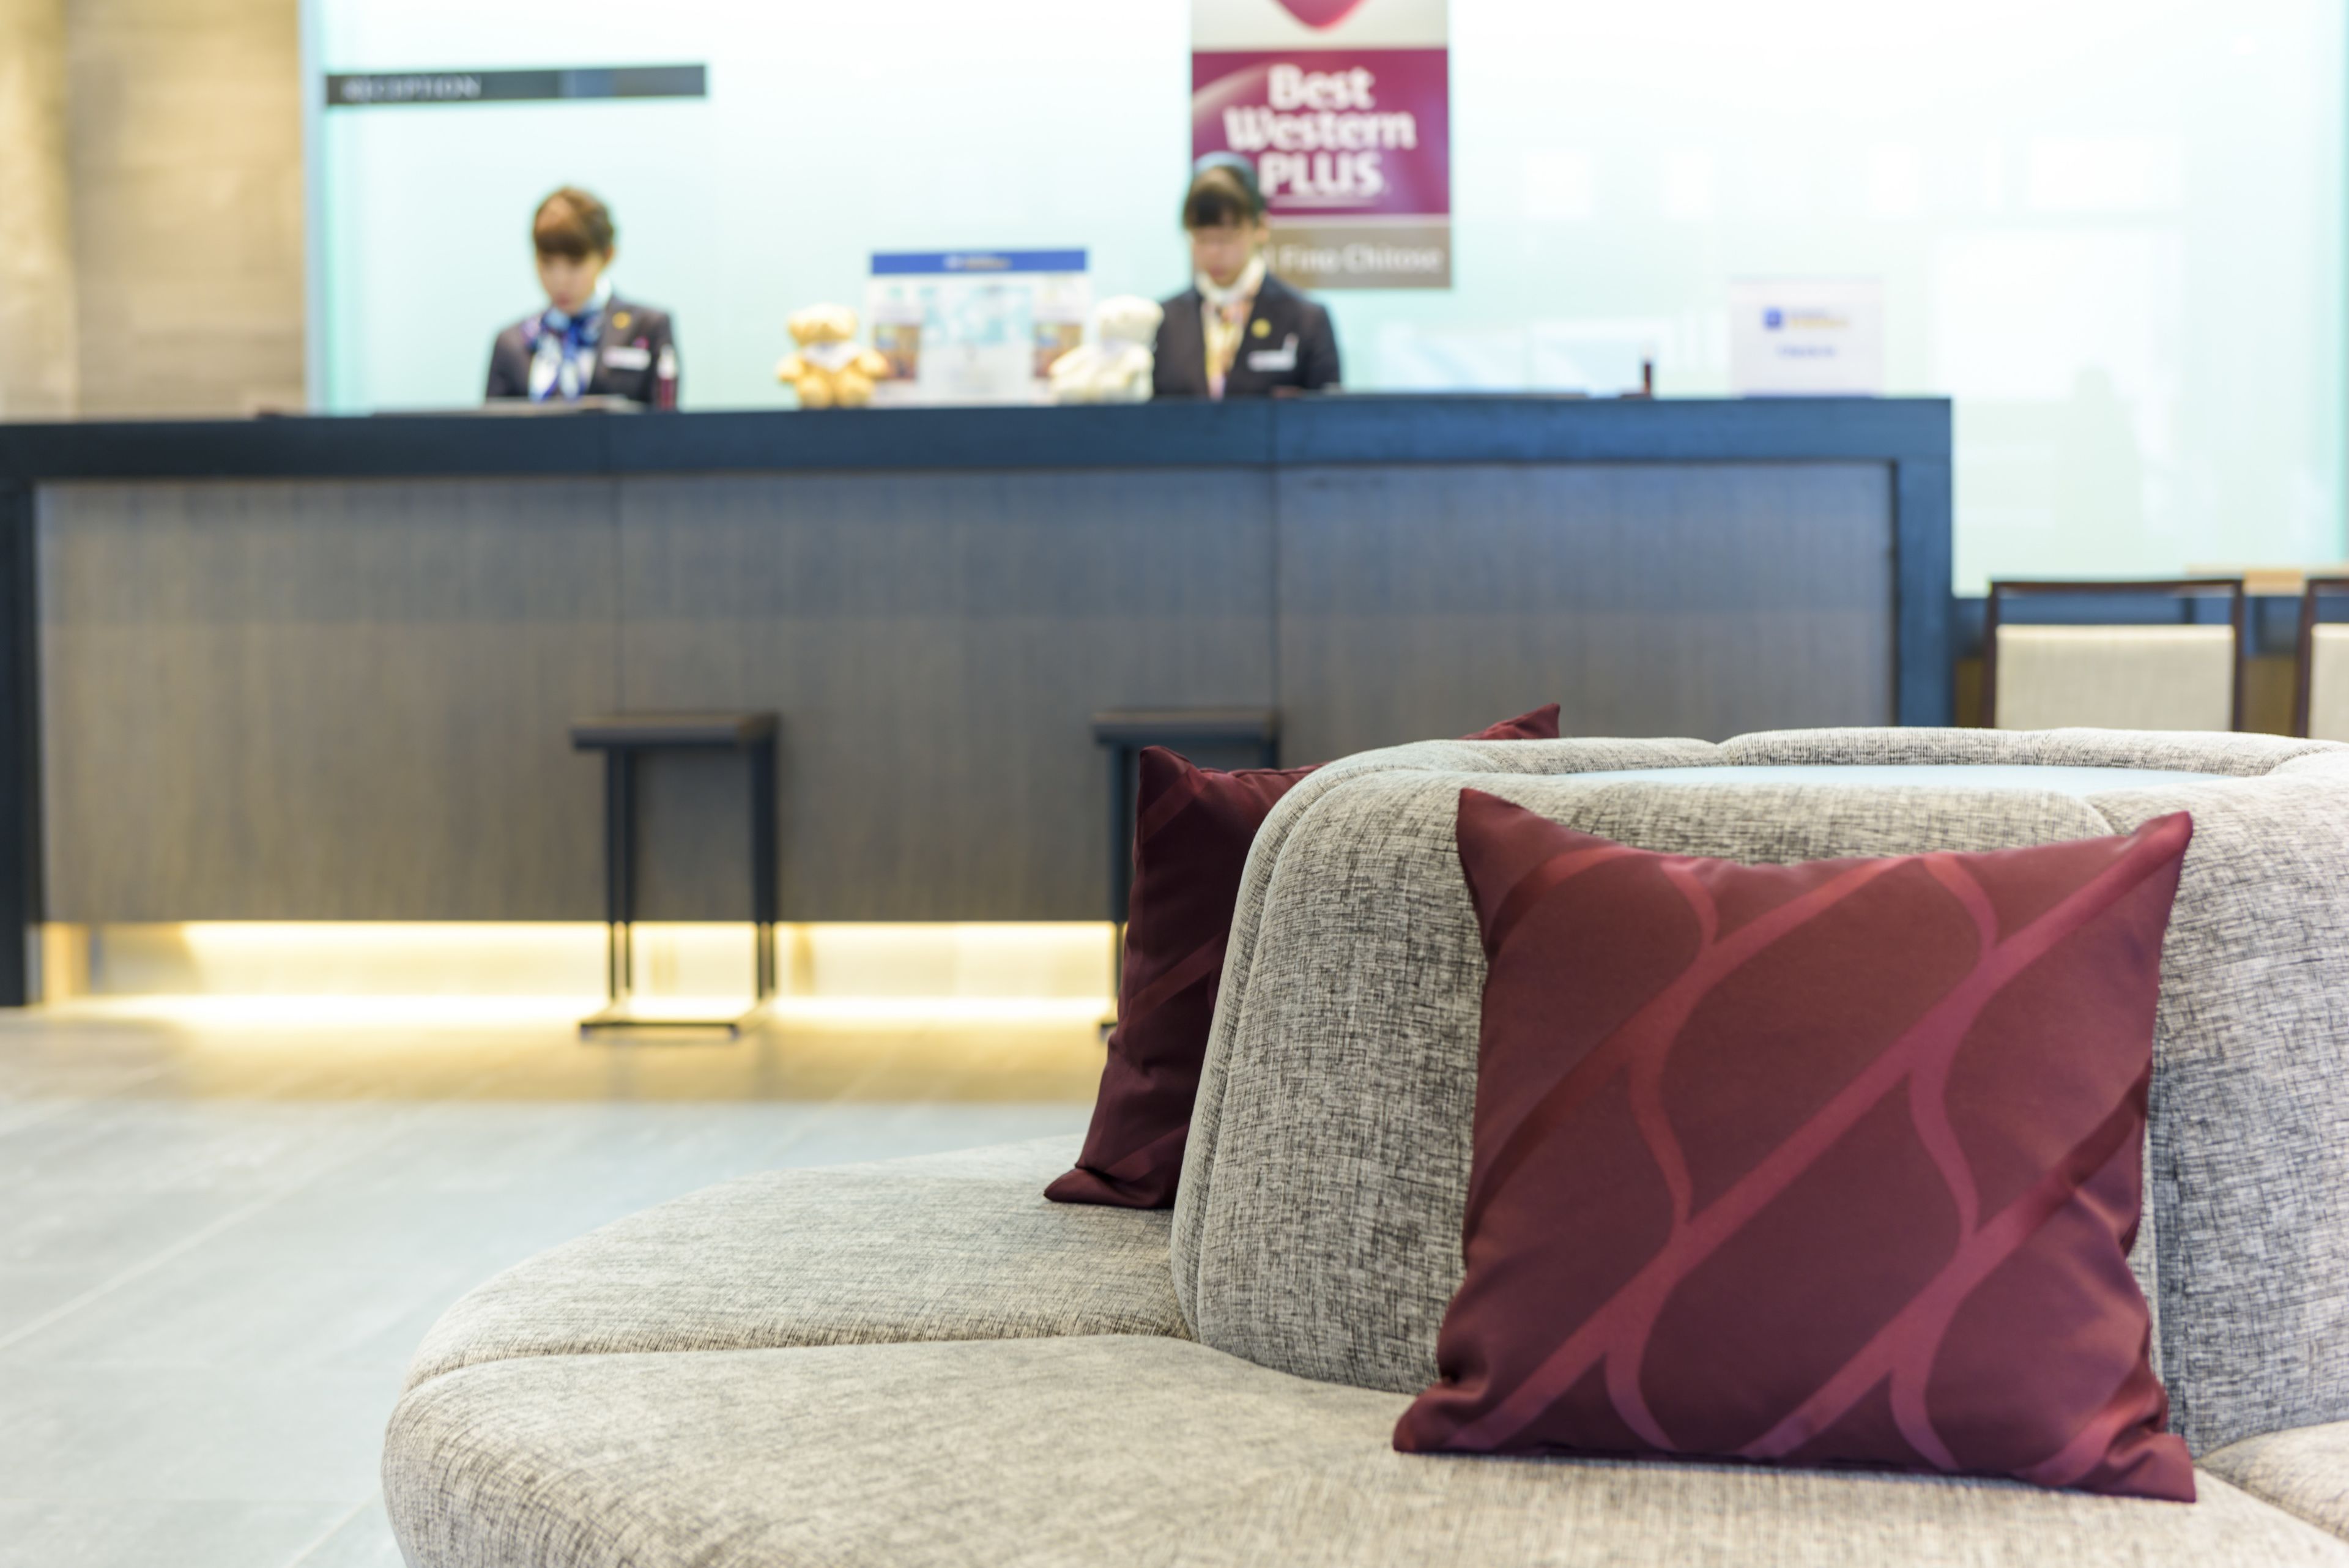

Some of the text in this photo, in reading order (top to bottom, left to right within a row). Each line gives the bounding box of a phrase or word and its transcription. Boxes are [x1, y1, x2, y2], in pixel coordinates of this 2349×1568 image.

[1269, 64, 1375, 110] Best
[1225, 106, 1417, 150] Western
[1258, 151, 1385, 198] PLUS
[1343, 242, 1445, 274] Chitose
